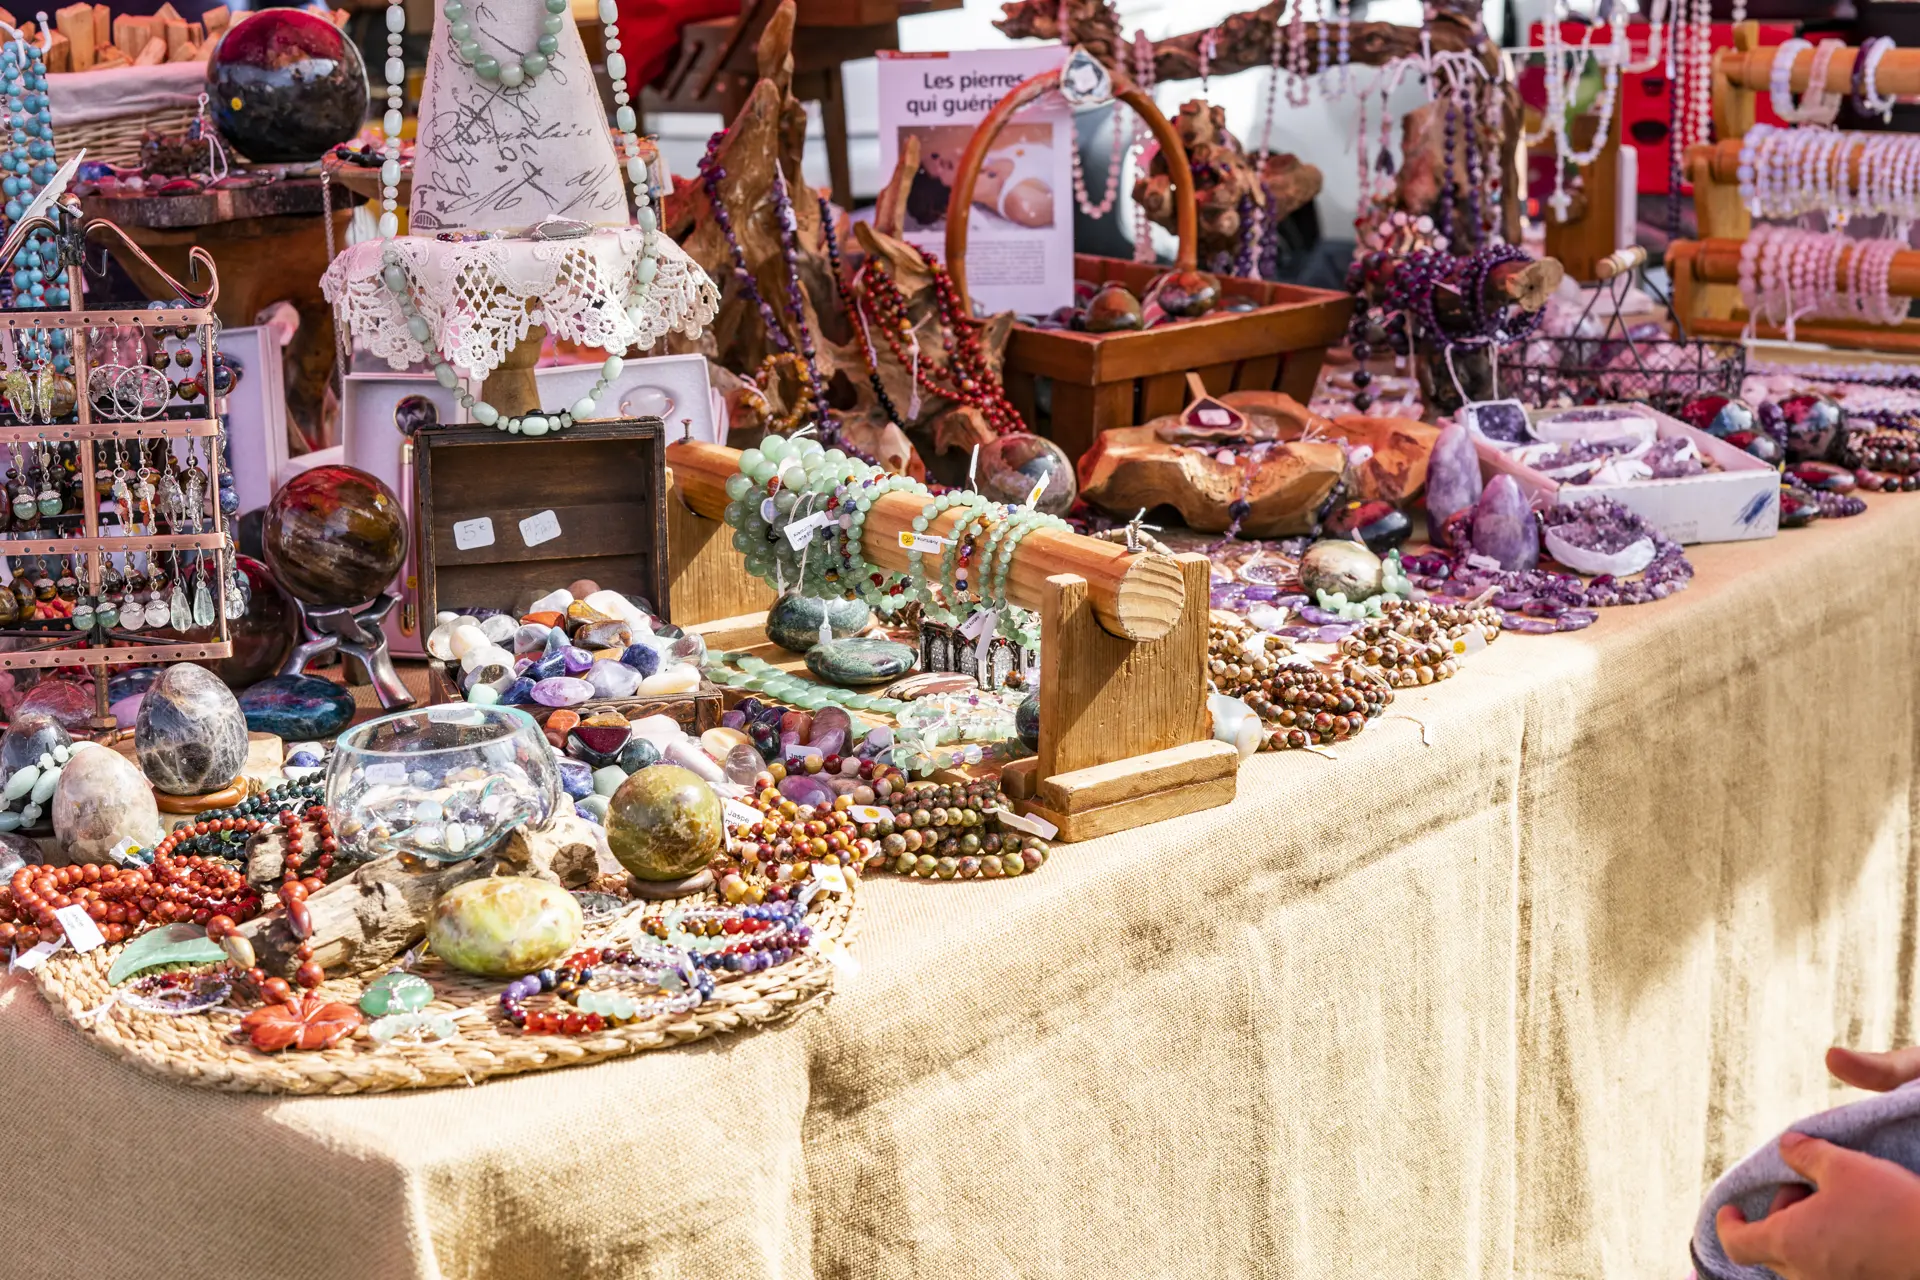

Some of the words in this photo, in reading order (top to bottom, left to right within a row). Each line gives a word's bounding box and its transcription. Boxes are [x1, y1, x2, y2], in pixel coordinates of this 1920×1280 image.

[924, 72, 955, 89] Les
[960, 70, 1025, 92] pierres
[906, 94, 937, 116] qui
[728, 810, 750, 824] Jaspe
